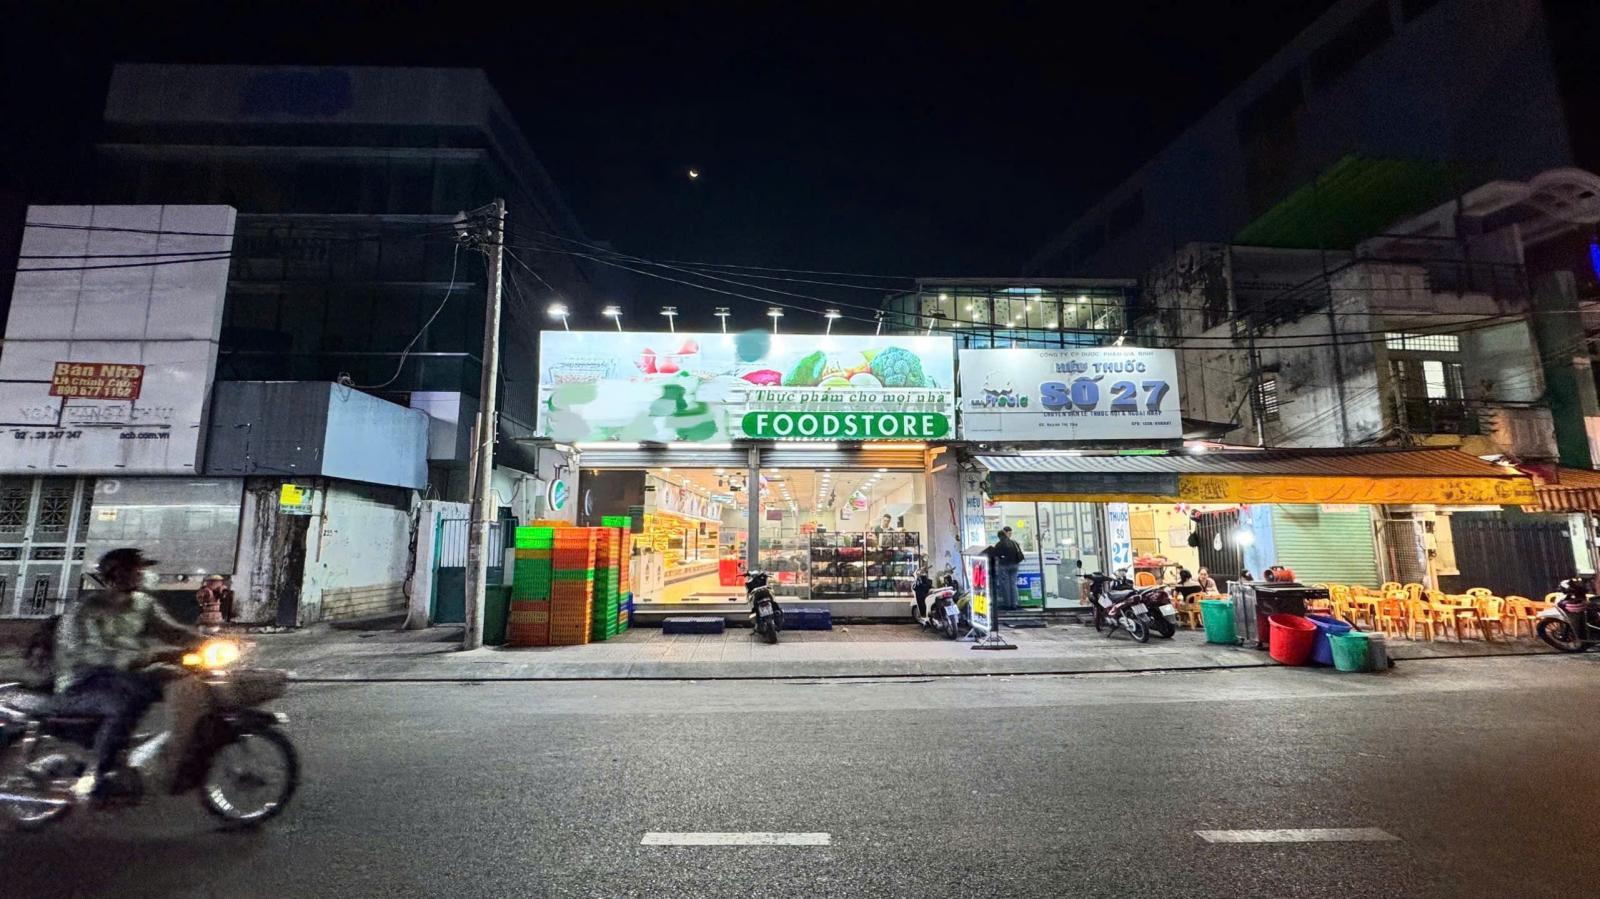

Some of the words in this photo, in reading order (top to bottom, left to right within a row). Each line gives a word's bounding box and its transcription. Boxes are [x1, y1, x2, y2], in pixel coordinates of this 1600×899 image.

[56, 362, 95, 377] Bán
[100, 364, 140, 379] Nhà
[1092, 360, 1146, 374] THUỐC
[54, 376, 69, 386] LH
[79, 386, 101, 396] 677
[755, 389, 795, 407] Thực
[800, 387, 844, 405] phẩm
[849, 390, 877, 404] cho
[882, 390, 911, 405] mọi
[917, 390, 945, 404] nhà
[1039, 375, 1105, 412] SỐ
[1109, 379, 1170, 413] 27
[756, 413, 935, 436] FOODSTORE
[119, 431, 170, 440] acb.com.vn
[1109, 509, 1128, 521] THUỐC
[1112, 542, 1130, 564] 27
